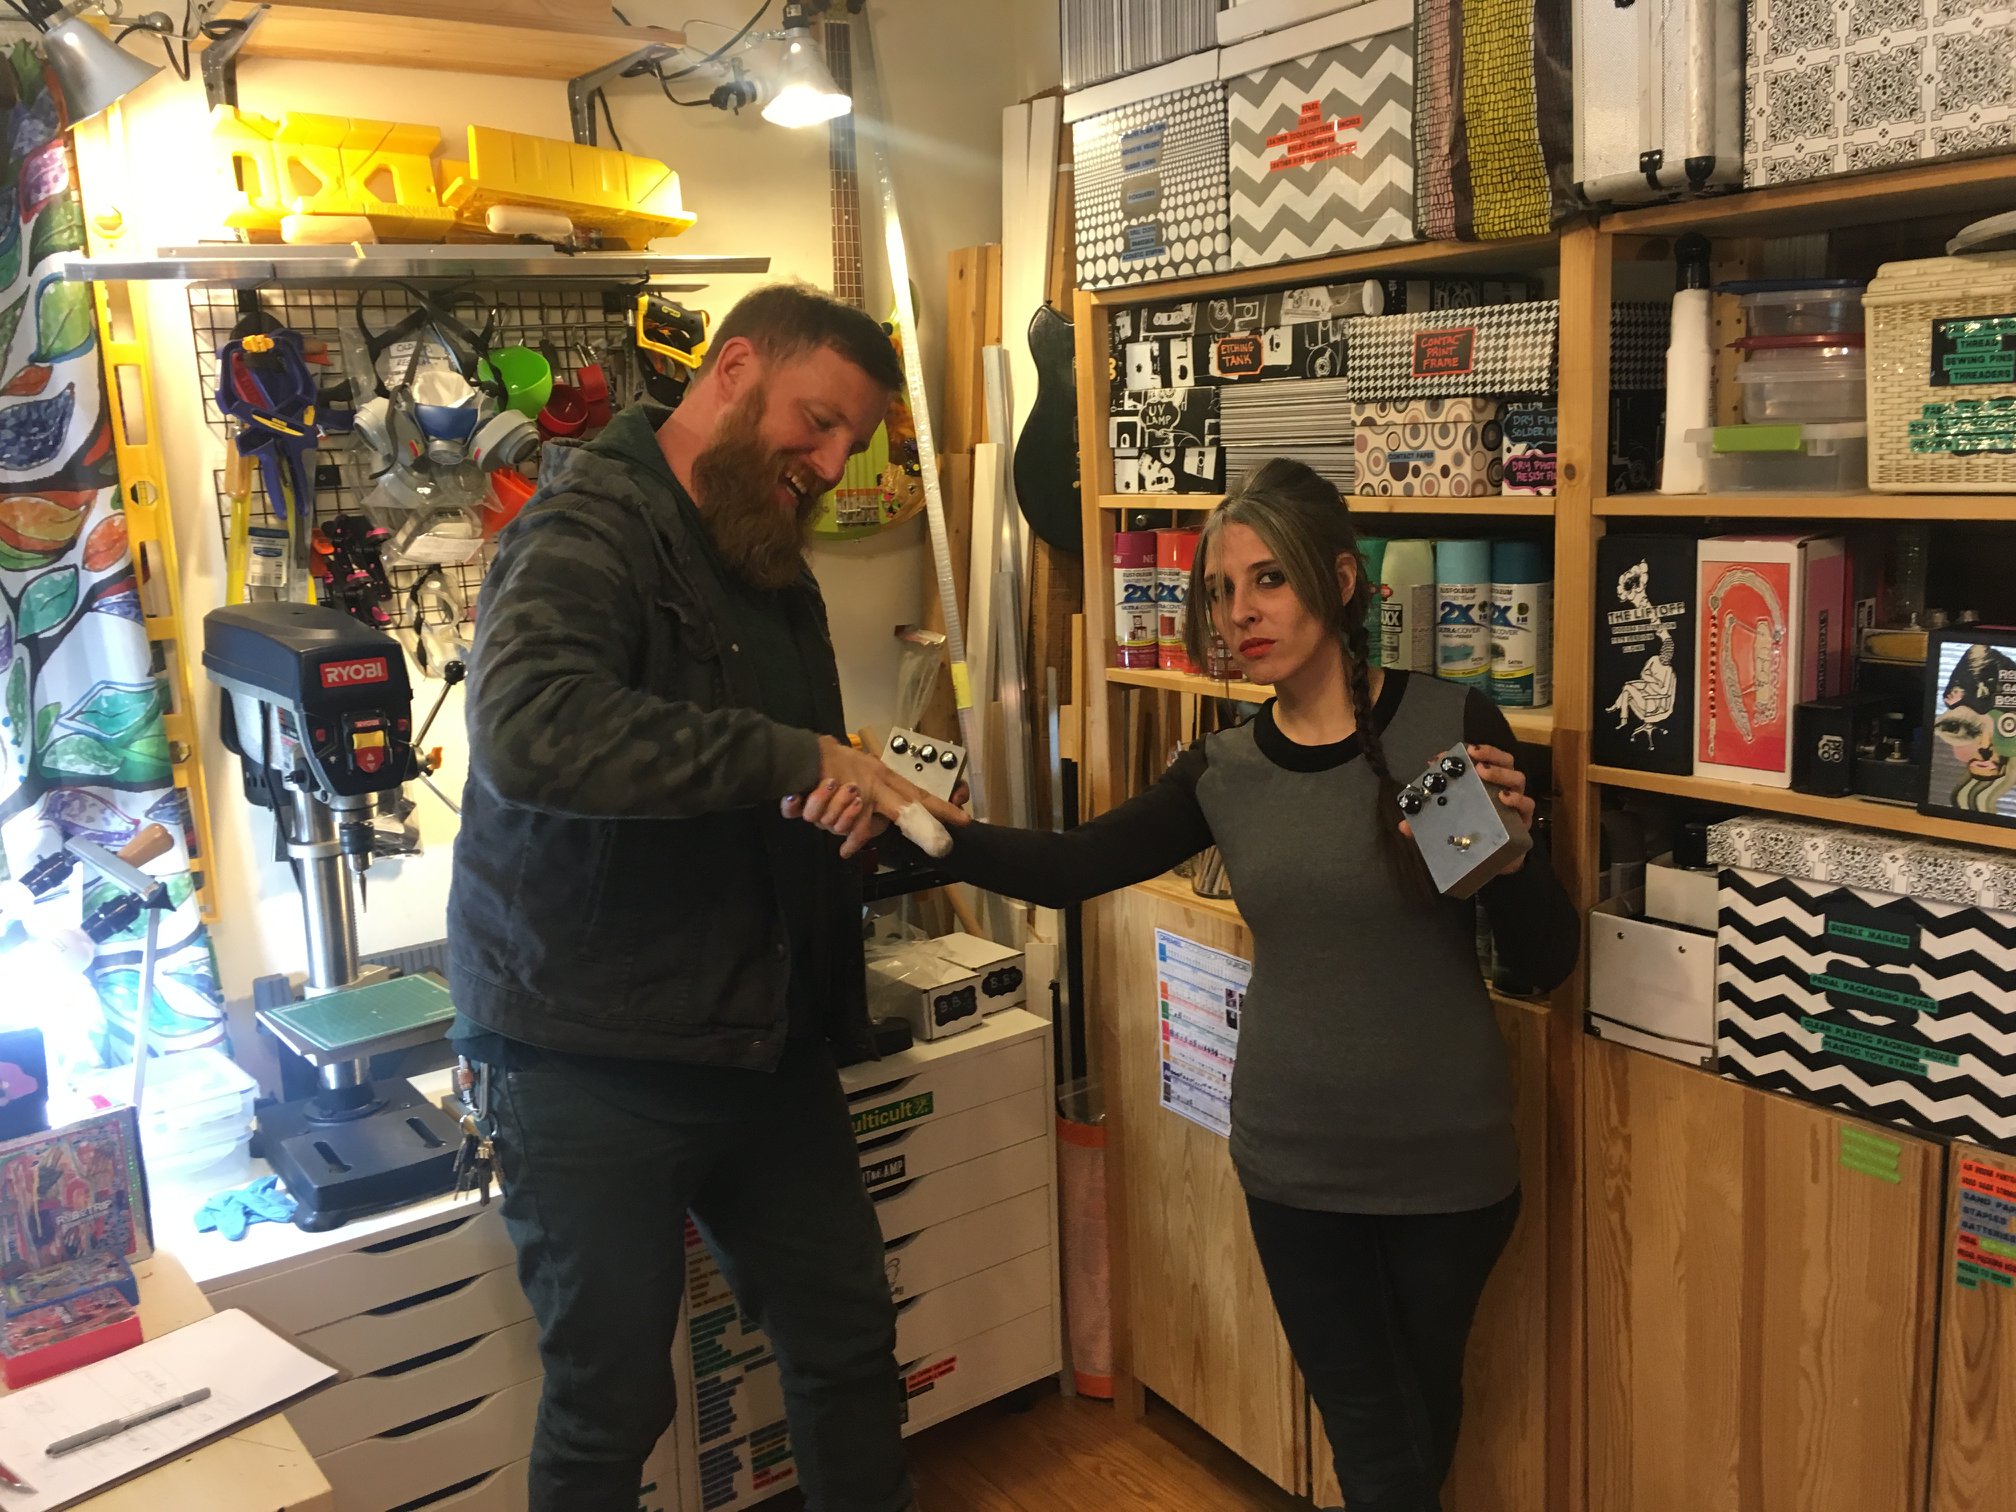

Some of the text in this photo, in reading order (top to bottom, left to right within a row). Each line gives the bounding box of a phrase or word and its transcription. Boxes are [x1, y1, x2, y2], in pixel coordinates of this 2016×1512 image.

[1421, 333, 1469, 348] CONTACT
[1960, 338, 2000, 349] THREAD
[1220, 341, 1254, 355] ETCHING
[1426, 346, 1458, 358] PRINT
[1221, 354, 1253, 367] TANK
[1423, 357, 1459, 370] FRAME
[1944, 353, 2013, 366] SEWING PINS
[1953, 369, 2011, 380] THREADERS
[1148, 403, 1166, 417] UV
[1146, 415, 1172, 426] LAMP
[1512, 414, 1534, 427] DRY
[1510, 426, 1545, 438] SOLDER
[1387, 452, 1415, 460] CONTACT
[1511, 460, 1531, 472] DRY
[1516, 470, 1545, 482] RESIST
[1123, 583, 1152, 603] 2X
[1440, 601, 1476, 625] 2X
[1607, 610, 1632, 624] THE
[325, 662, 383, 683] RYOBI
[1830, 922, 1910, 946] BUBBLE MAILERS
[1811, 974, 1937, 1011] PEDAL PACKAGING BOXES
[1804, 1018, 1959, 1065] CLEAR PLASTIC PACKING BOXES
[1822, 1040, 1928, 1073] PLASTIC TOY STANDS
[851, 1101, 913, 1134] ulticult
[1963, 1191, 1992, 1206] SAND
[1962, 1206, 2008, 1225] STAPLES
[1961, 1220, 2016, 1243] BATTERIES
